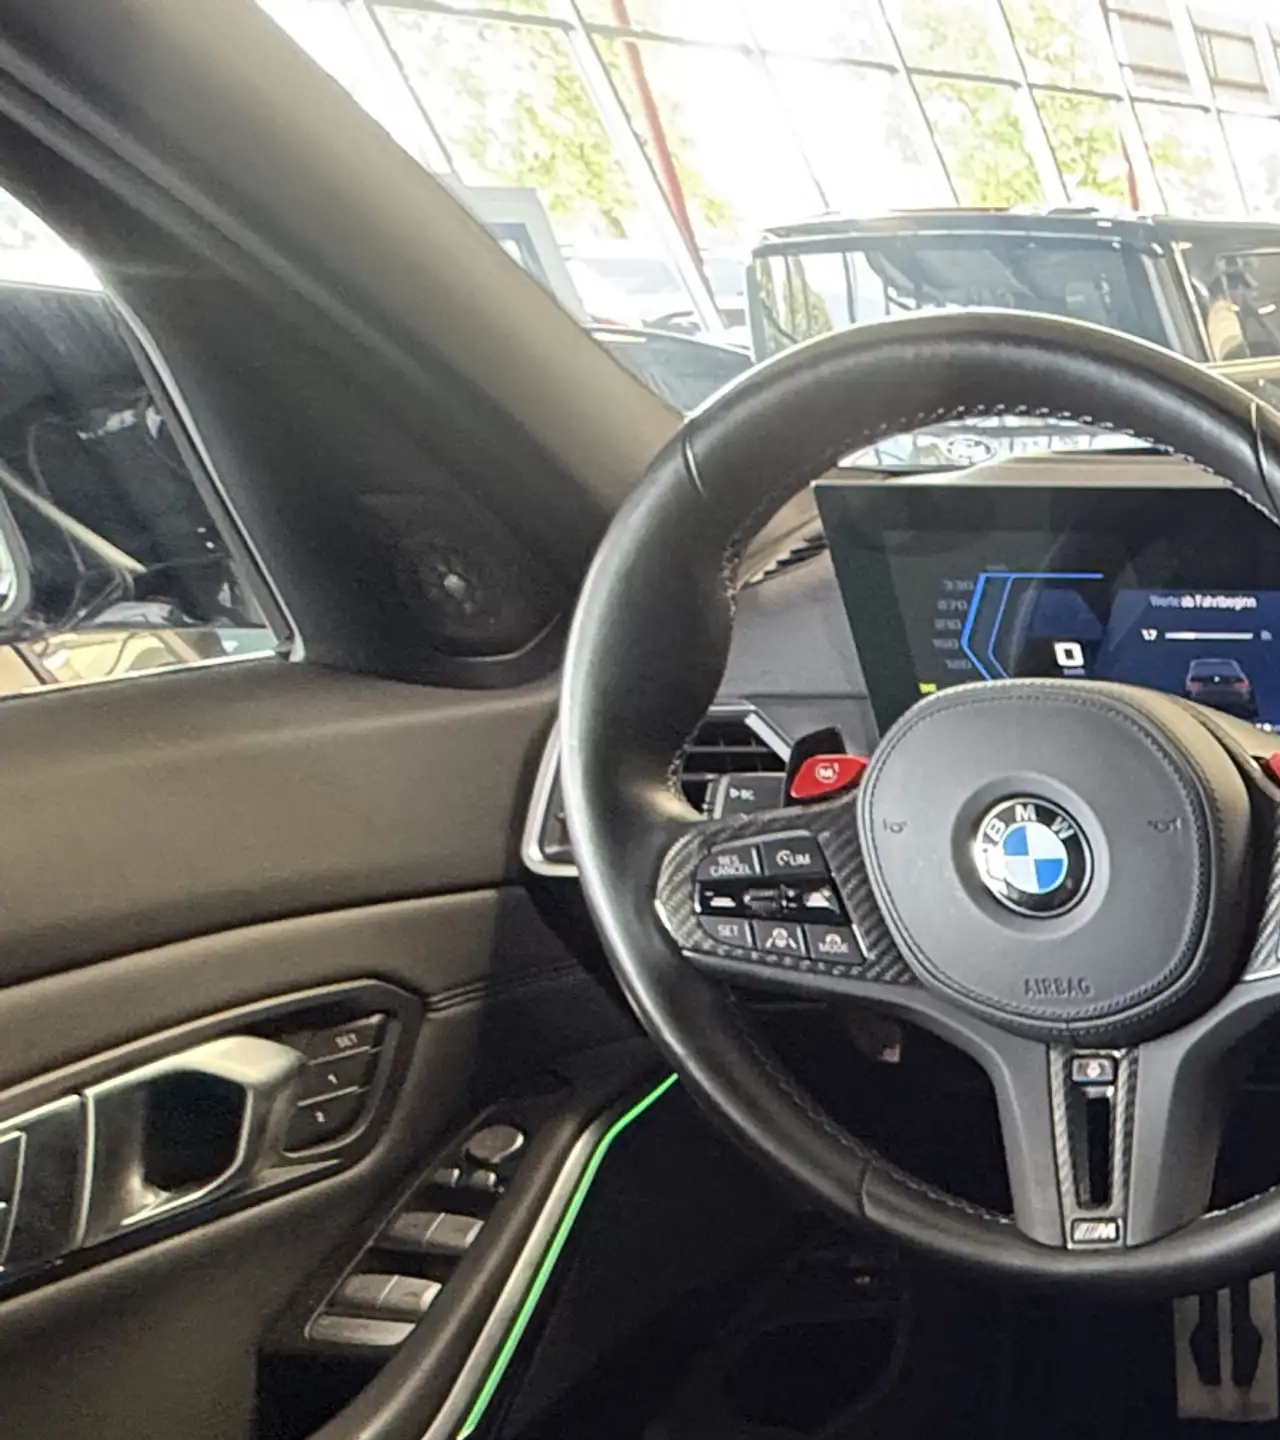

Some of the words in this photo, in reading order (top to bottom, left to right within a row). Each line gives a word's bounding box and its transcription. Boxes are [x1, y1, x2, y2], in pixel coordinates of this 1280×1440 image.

[986, 803, 1075, 842] BMW
[709, 863, 753, 878] CANCEL
[717, 924, 739, 937] SET
[1022, 976, 1092, 999] AIRBAG
